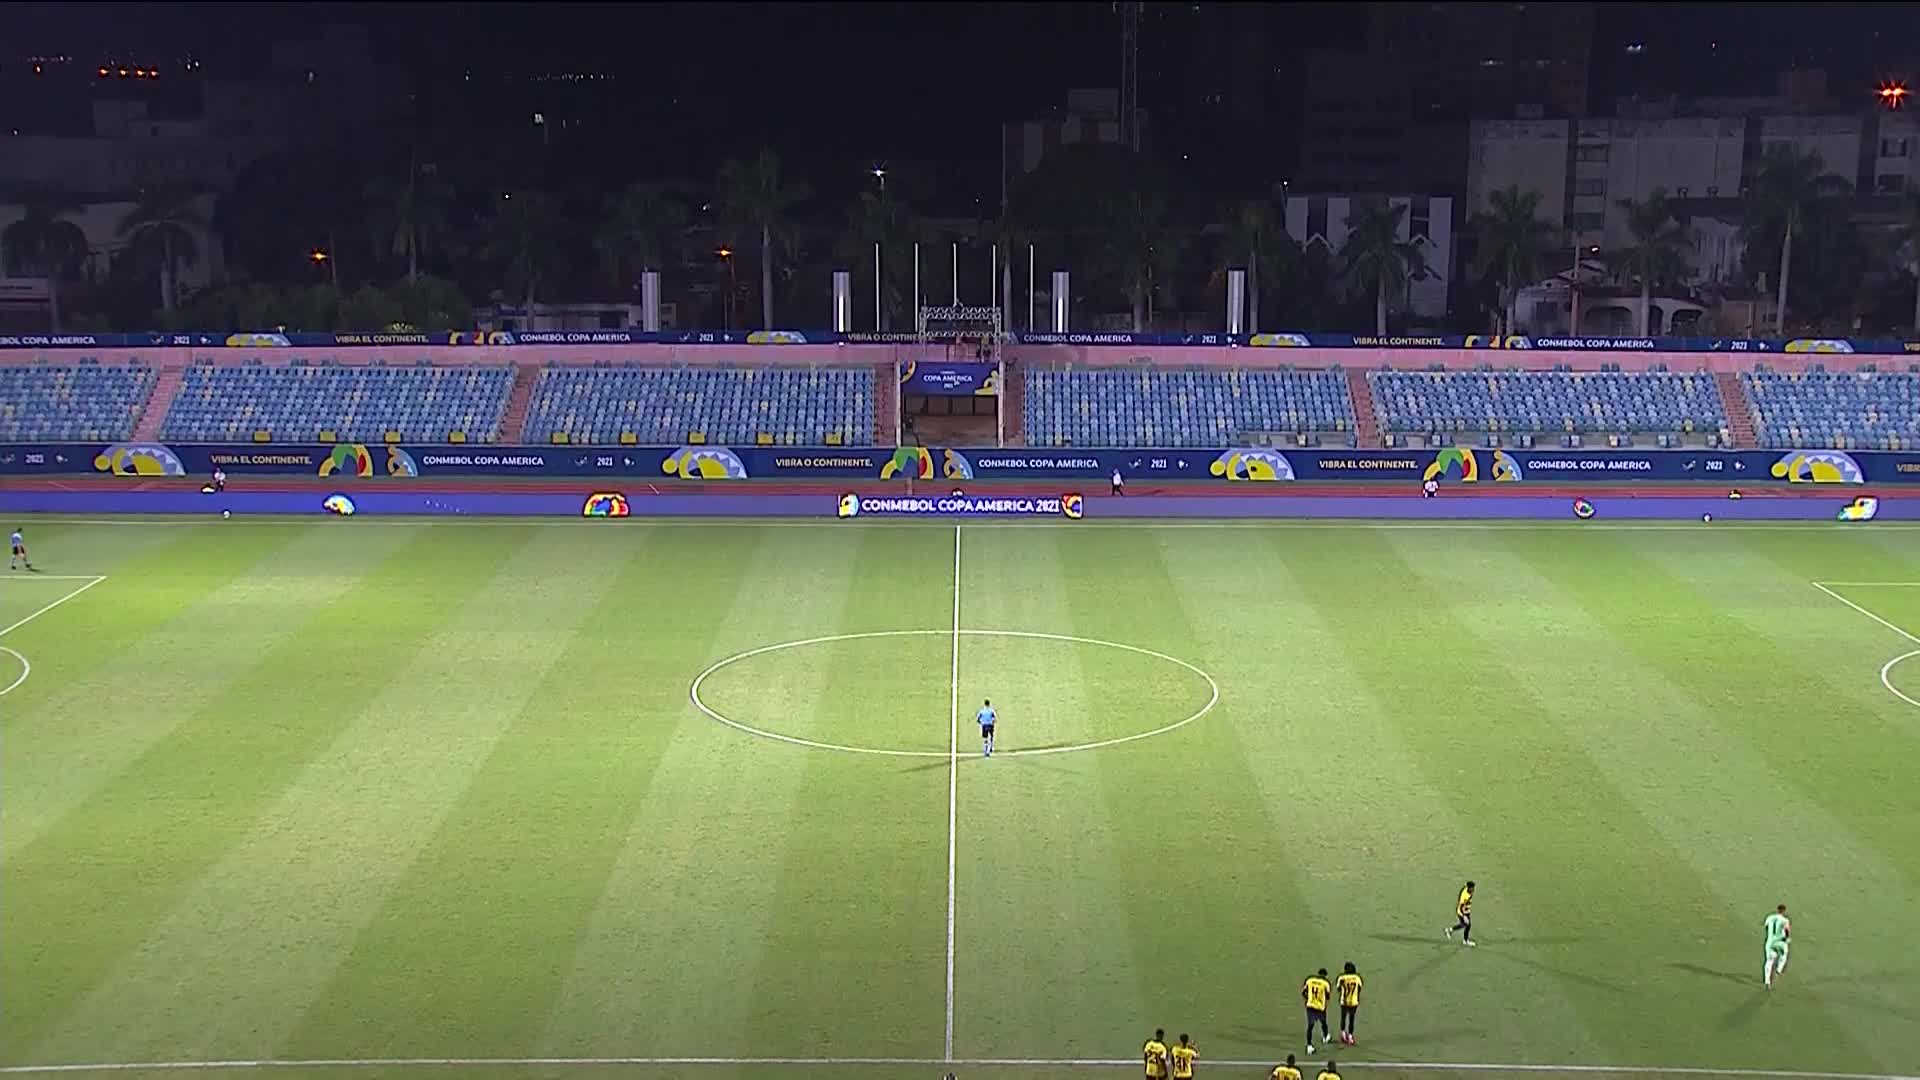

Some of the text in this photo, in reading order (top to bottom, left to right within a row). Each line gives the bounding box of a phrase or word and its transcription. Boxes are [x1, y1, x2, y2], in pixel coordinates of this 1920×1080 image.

[22, 336, 50, 345] COPA
[51, 336, 96, 345] AMERICA
[174, 336, 190, 345] 2021
[335, 335, 361, 344] VIBRA
[520, 334, 631, 342] CONMEBOL COPA AMERICA
[699, 333, 714, 342] 2021
[848, 333, 872, 342] VIBRA
[873, 333, 881, 342] O
[1023, 334, 1132, 343] CONMEBOL COPA AMERICA
[1202, 335, 1217, 344] 2021
[1353, 336, 1379, 345] VIBRA
[1380, 336, 1389, 345] EL
[1537, 339, 1654, 348] CONMEBOL COPA AMERICA
[1730, 341, 1747, 350] 2021
[923, 374, 941, 382] COPA
[25, 455, 44, 464] 2021
[211, 455, 241, 464] VIBRA
[241, 455, 251, 464] EL
[422, 456, 544, 465] CONMEBOL COPA AMERICA
[597, 457, 613, 466] 2021
[775, 458, 803, 467] VIBRA
[804, 458, 811, 467] O
[978, 459, 1099, 468] CONMEBOL COPA AMERICA
[1151, 459, 1167, 468] 2021
[1319, 460, 1347, 469] VIBRA
[1347, 460, 1358, 469] EL
[1528, 460, 1651, 470] CONMEBOL COPA AMERICA
[1705, 461, 1723, 470] 2021
[861, 499, 1060, 512] CONMEBOL COPA AMERICA 2021
